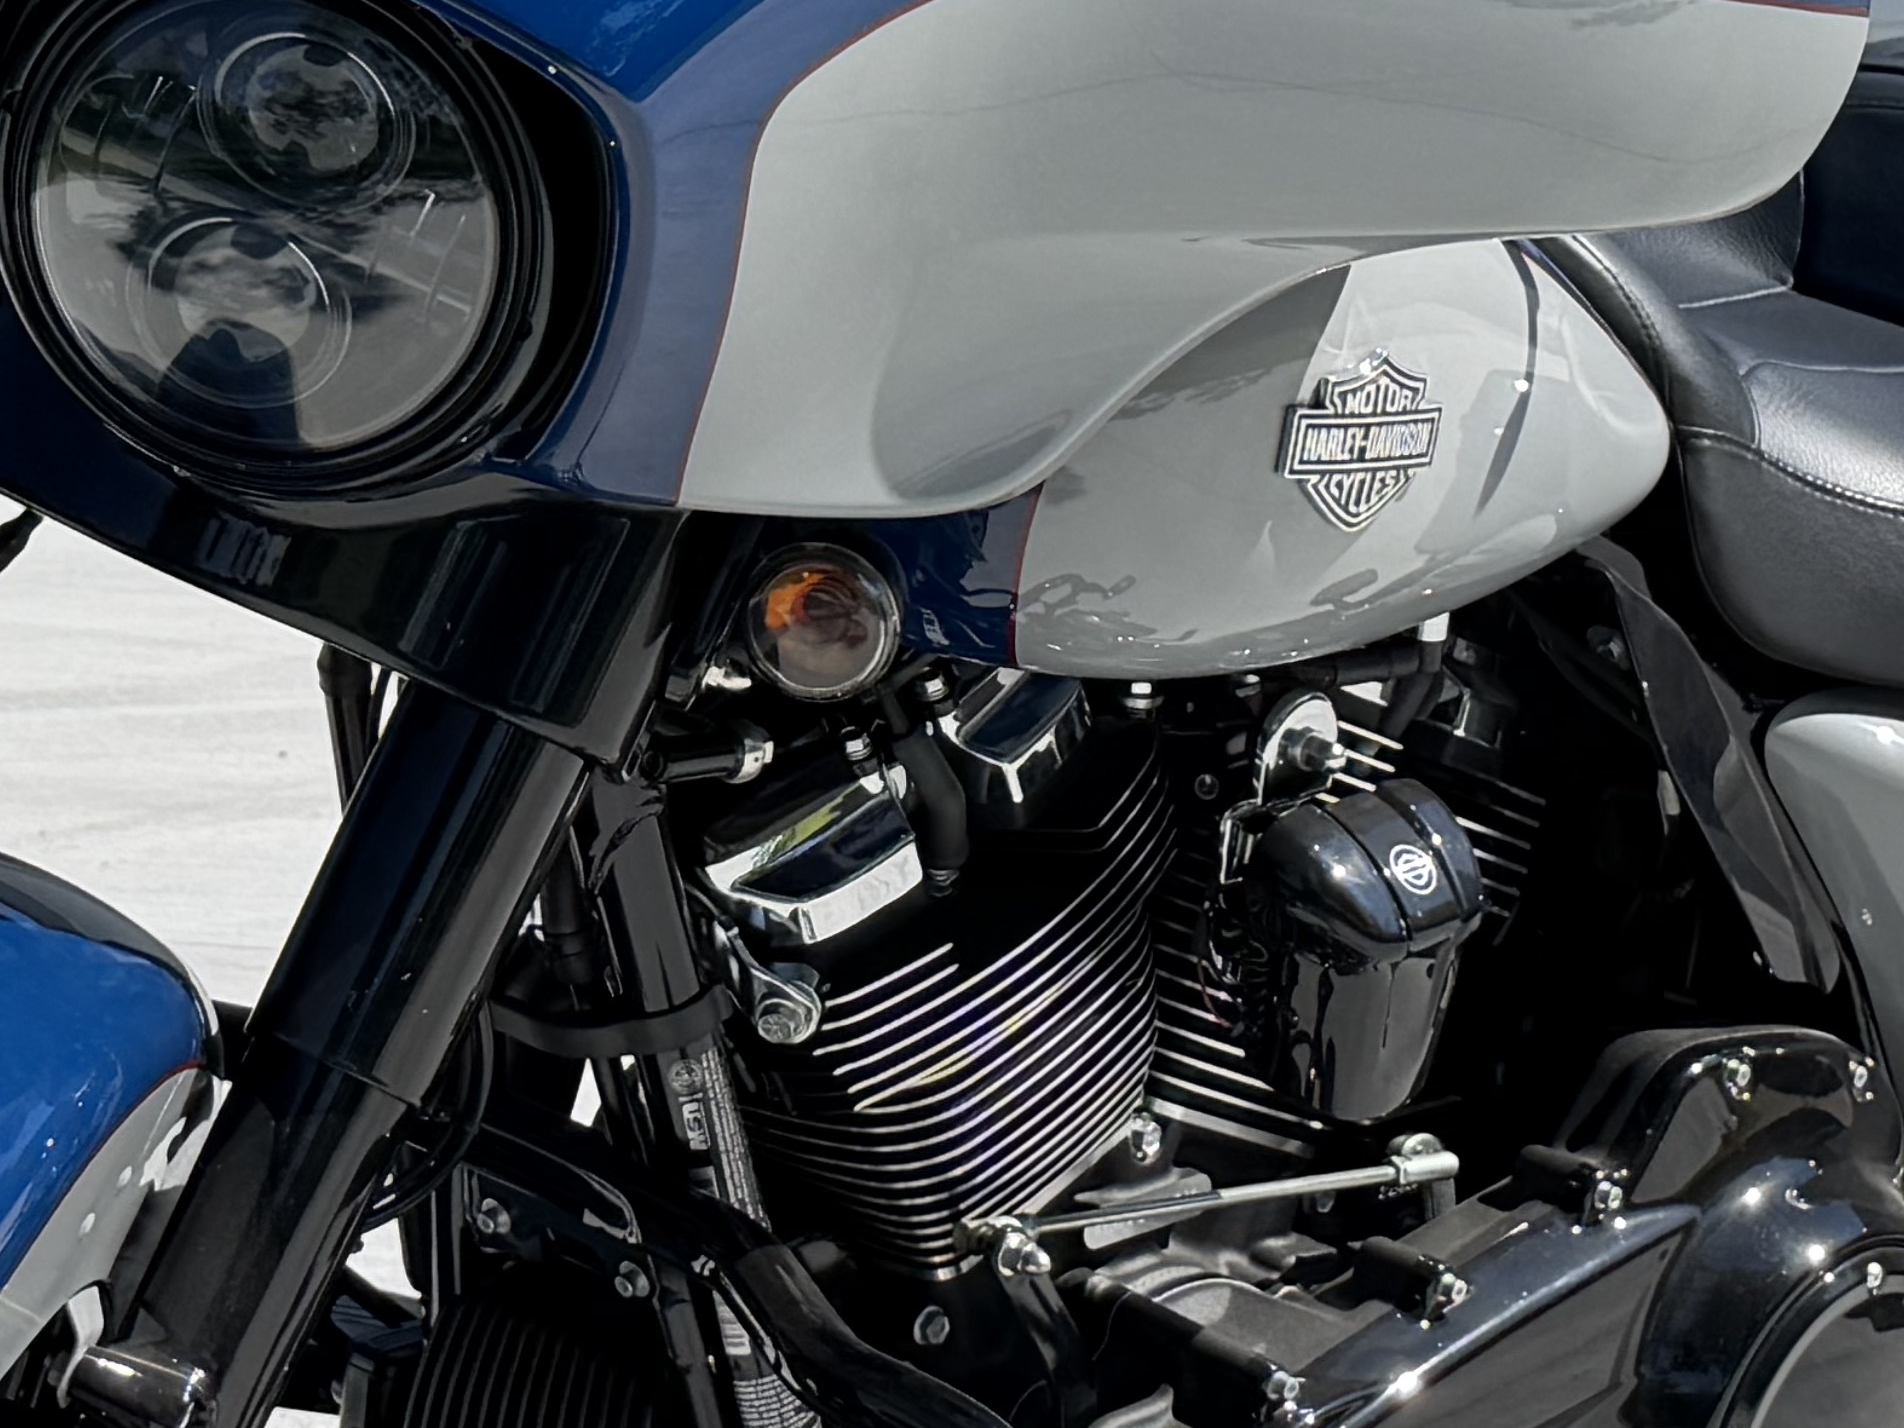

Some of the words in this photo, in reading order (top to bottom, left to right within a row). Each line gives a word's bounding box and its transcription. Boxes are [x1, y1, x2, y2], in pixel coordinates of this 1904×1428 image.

[1344, 376, 1414, 414] MOTOR
[1302, 421, 1433, 462] HARLEY-DAVIDSON
[1329, 469, 1398, 514] CYCLES
